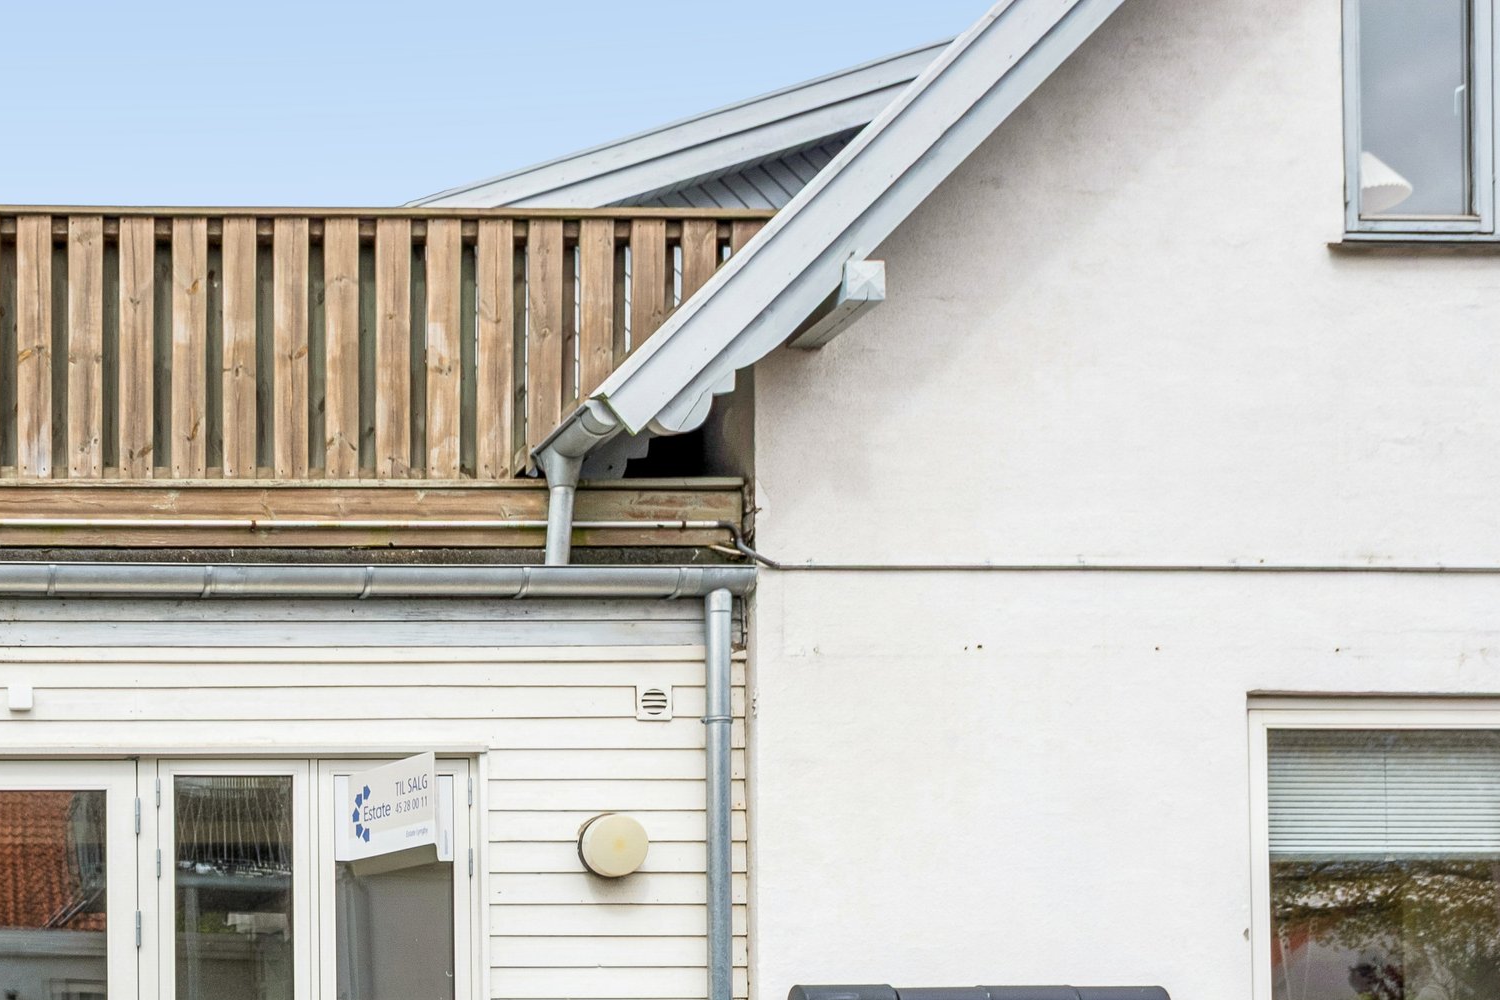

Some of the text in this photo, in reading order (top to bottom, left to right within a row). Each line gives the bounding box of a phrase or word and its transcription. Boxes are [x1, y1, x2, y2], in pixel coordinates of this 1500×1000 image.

[395, 774, 428, 796] TIL SALG
[363, 803, 391, 822] Estate
[403, 800, 411, 812] 28
[412, 798, 420, 810] 00
[421, 796, 428, 807] 11
